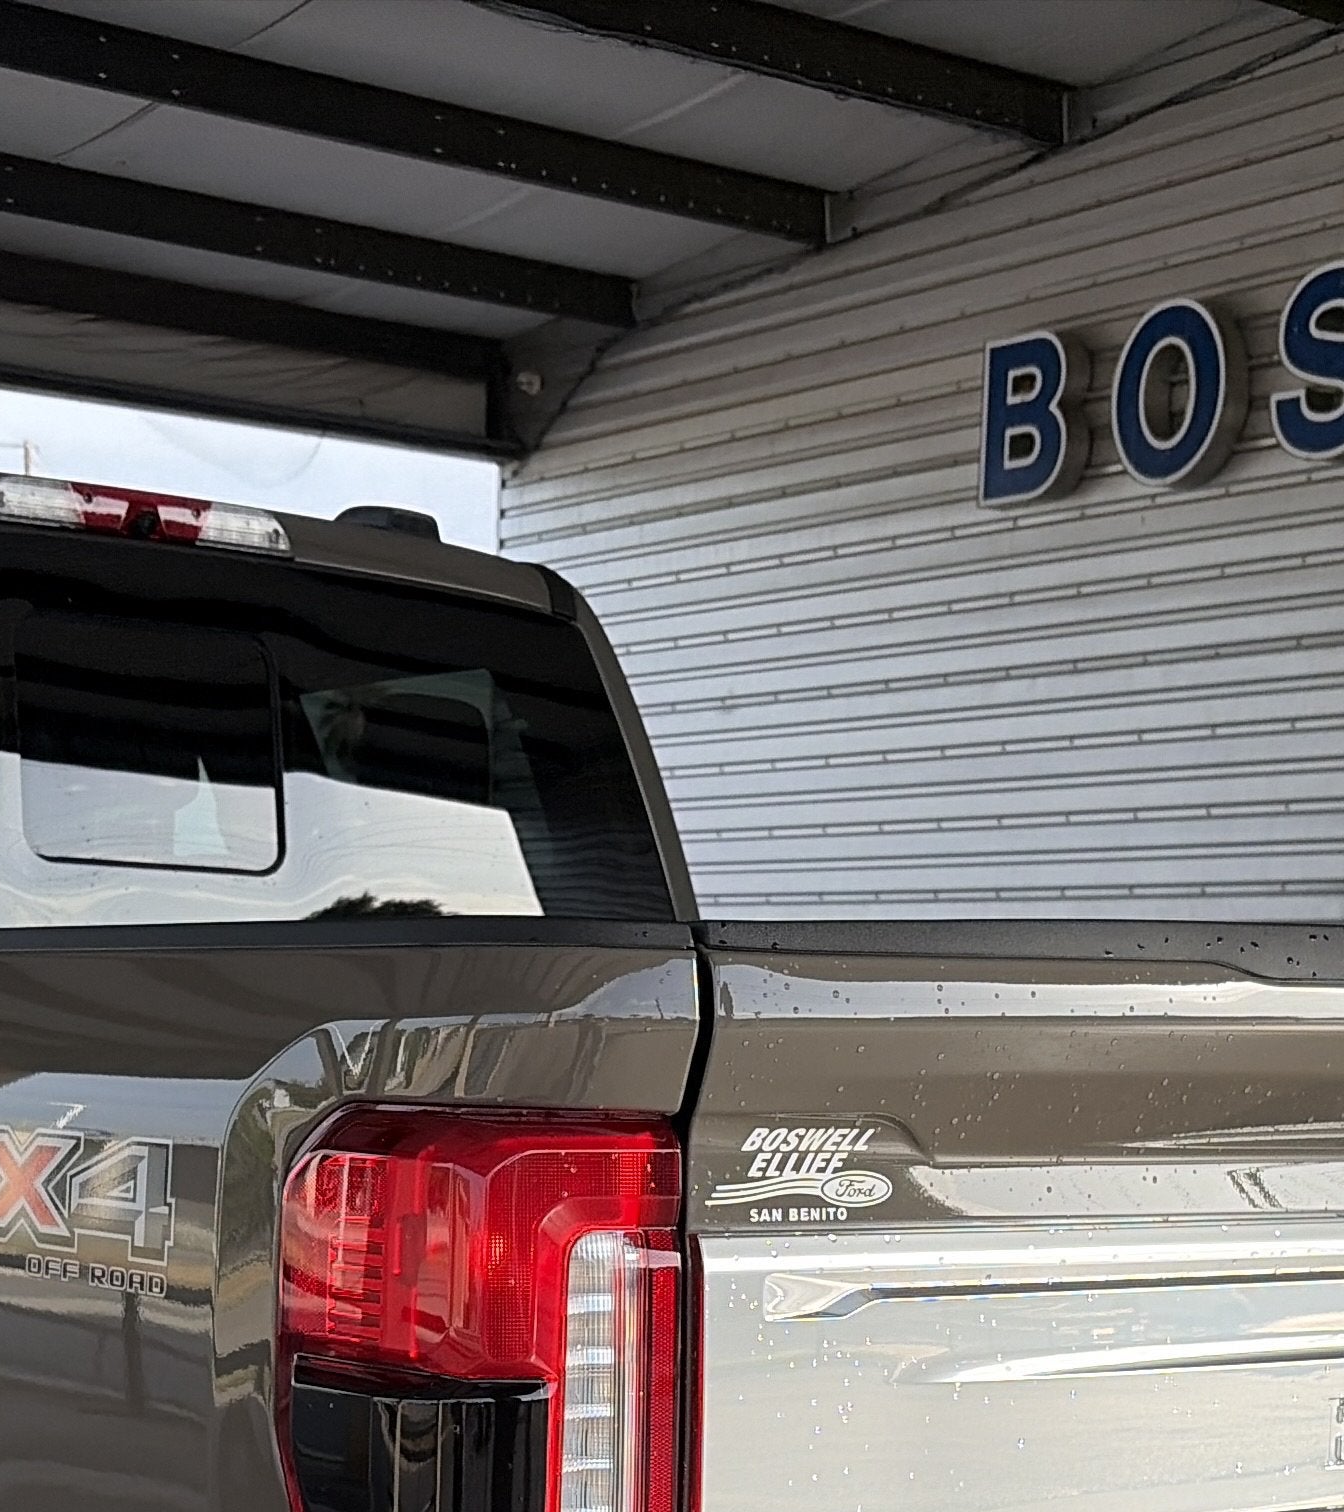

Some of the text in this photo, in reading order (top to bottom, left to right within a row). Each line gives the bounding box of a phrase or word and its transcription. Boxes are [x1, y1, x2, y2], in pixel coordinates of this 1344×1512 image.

[741, 1127, 876, 1152] BOSWELL
[747, 1152, 849, 1178] ELLIFF
[835, 1178, 877, 1198] Ford
[749, 1207, 848, 1223] SAN BENITO
[25, 1253, 167, 1297] OFF ROAD
